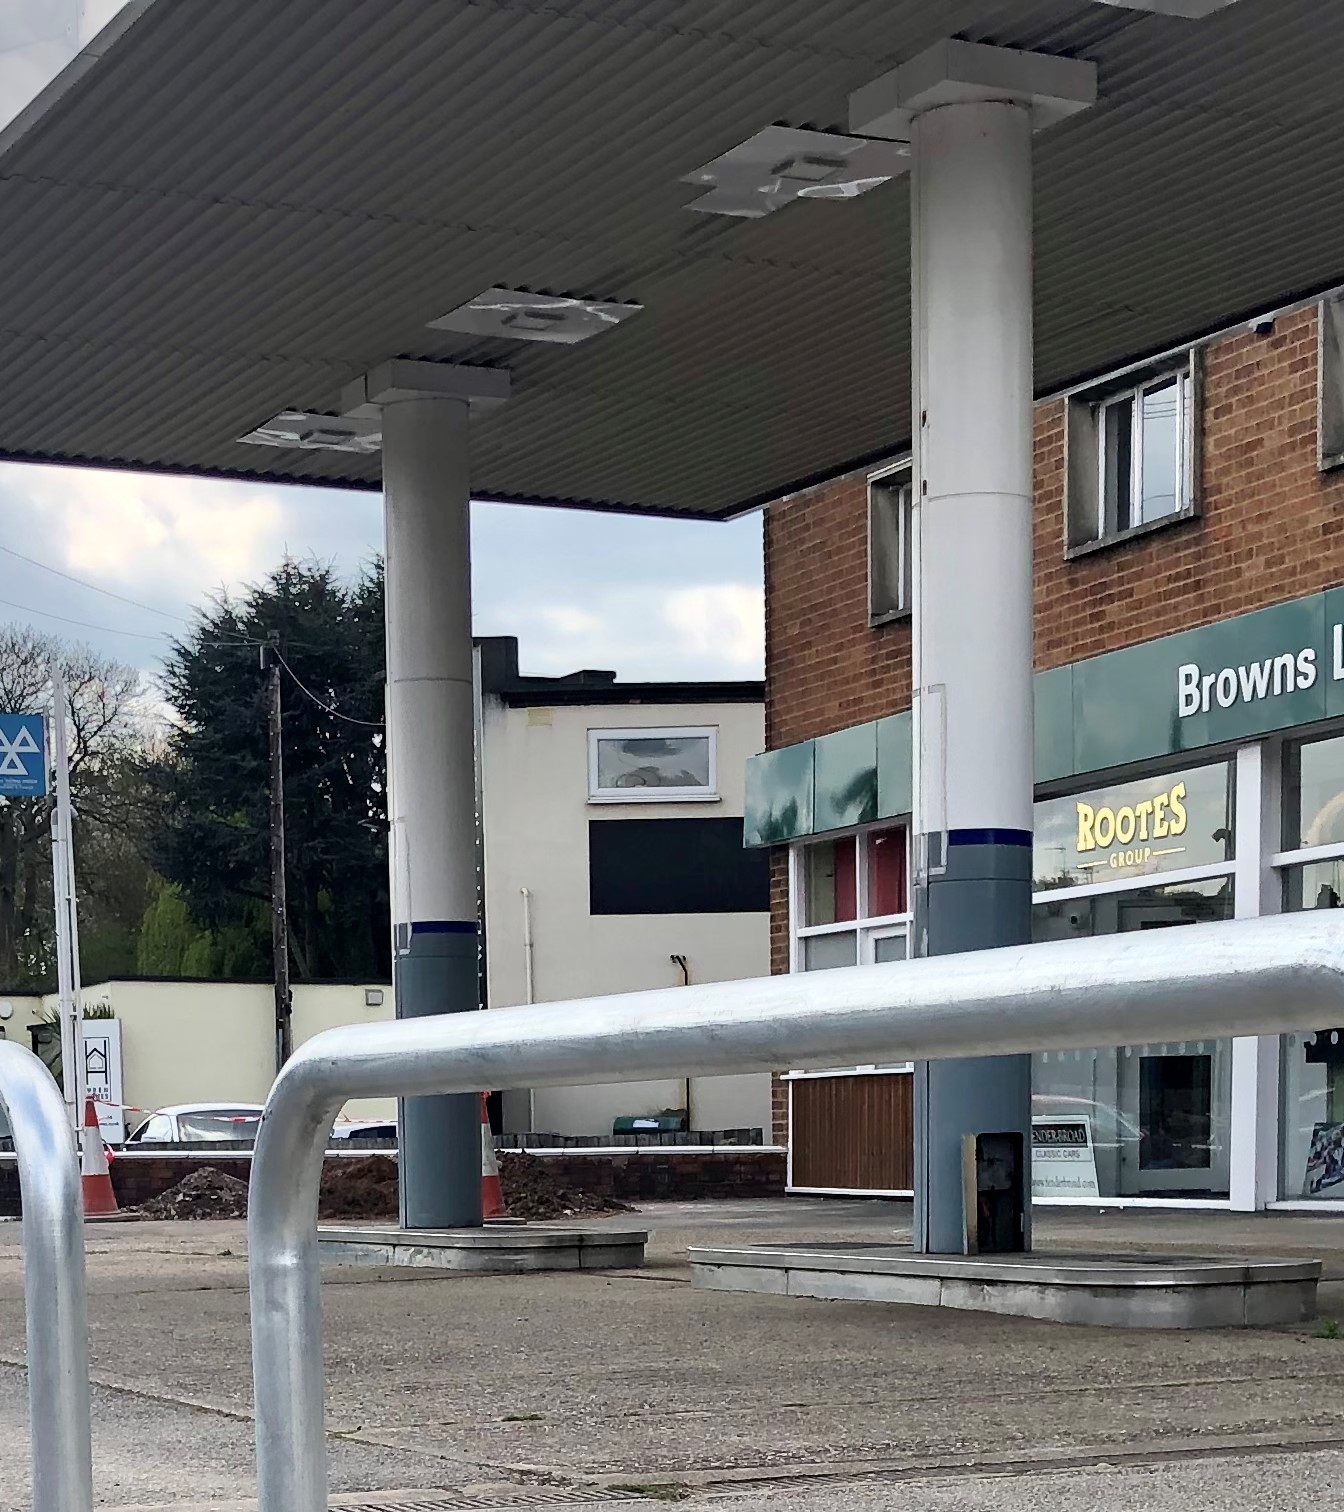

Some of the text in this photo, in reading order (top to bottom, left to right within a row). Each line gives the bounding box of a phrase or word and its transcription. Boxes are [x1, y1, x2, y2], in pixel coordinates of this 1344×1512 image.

[1178, 645, 1318, 718] Browns
[1076, 781, 1187, 852] ROOTES
[1109, 847, 1152, 868] GROUP
[1036, 1149, 1081, 1158] CLASSIC CARS
